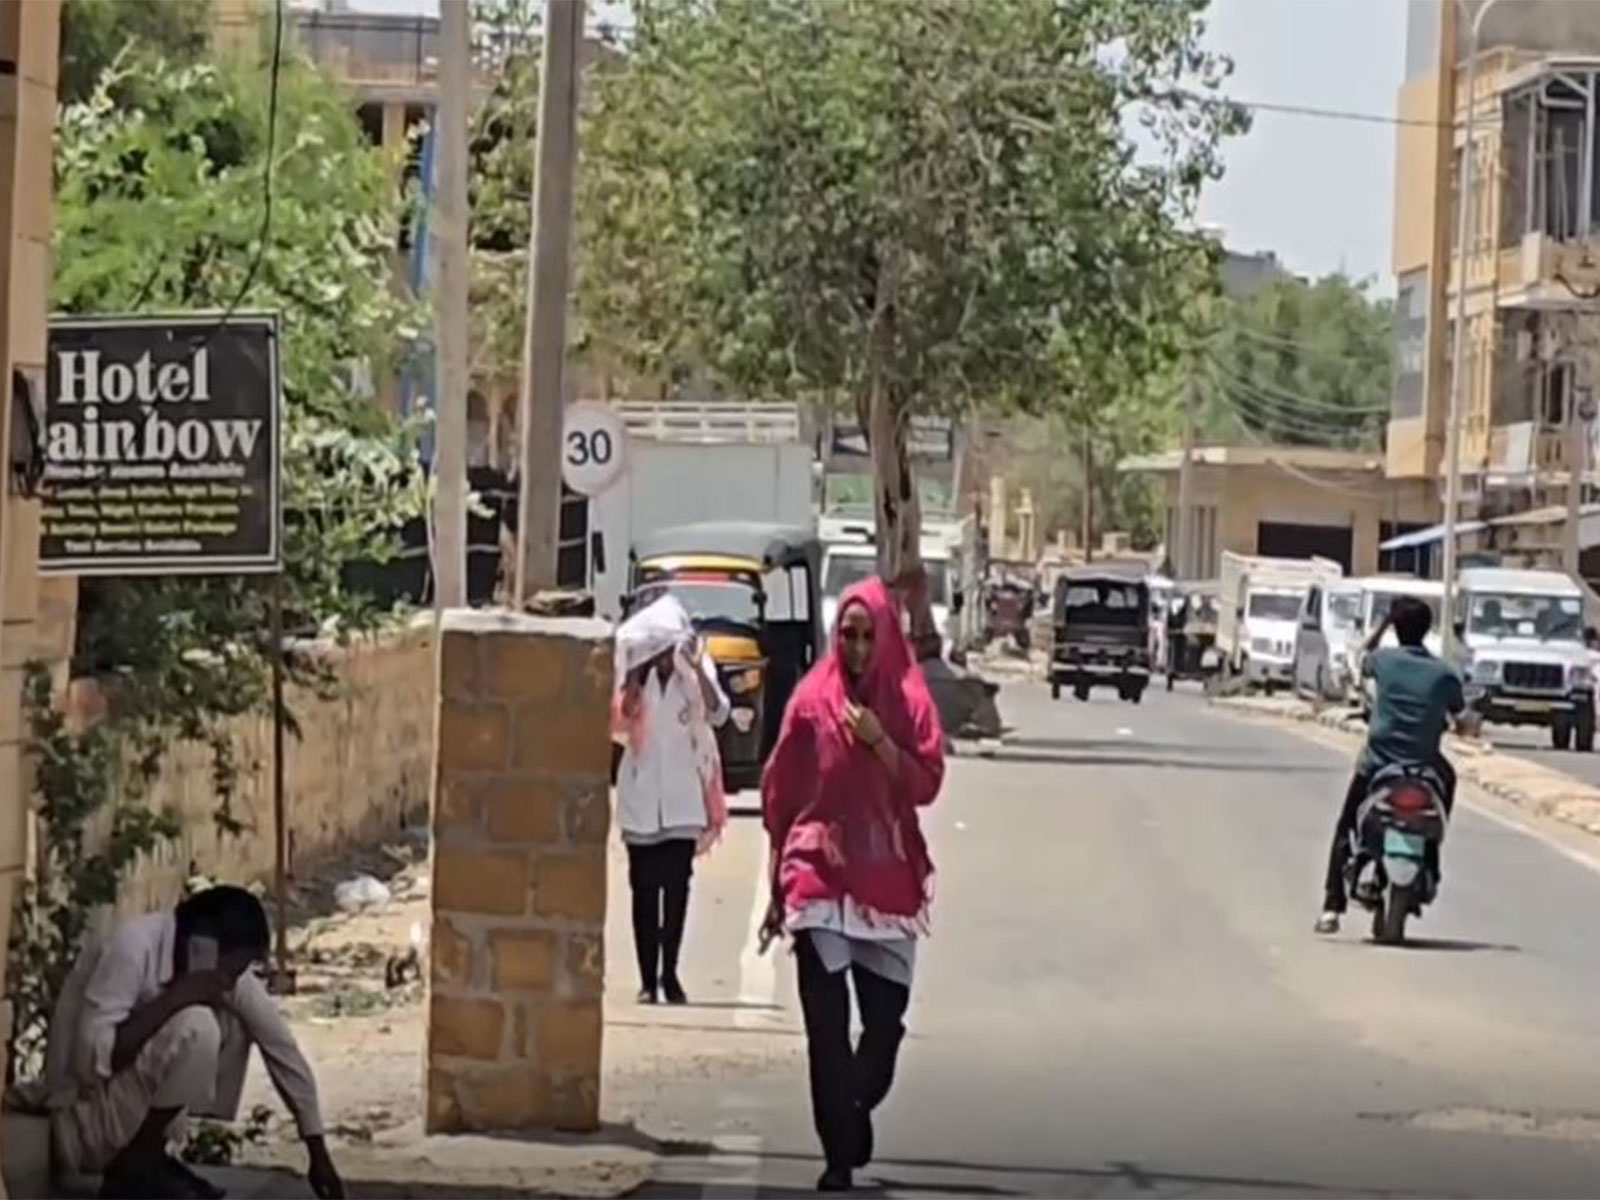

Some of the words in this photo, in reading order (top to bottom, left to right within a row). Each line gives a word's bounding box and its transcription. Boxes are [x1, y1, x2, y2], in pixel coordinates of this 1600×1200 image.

[58, 347, 210, 404] Hotel
[47, 405, 263, 462] ainbow
[567, 429, 612, 466] 30
